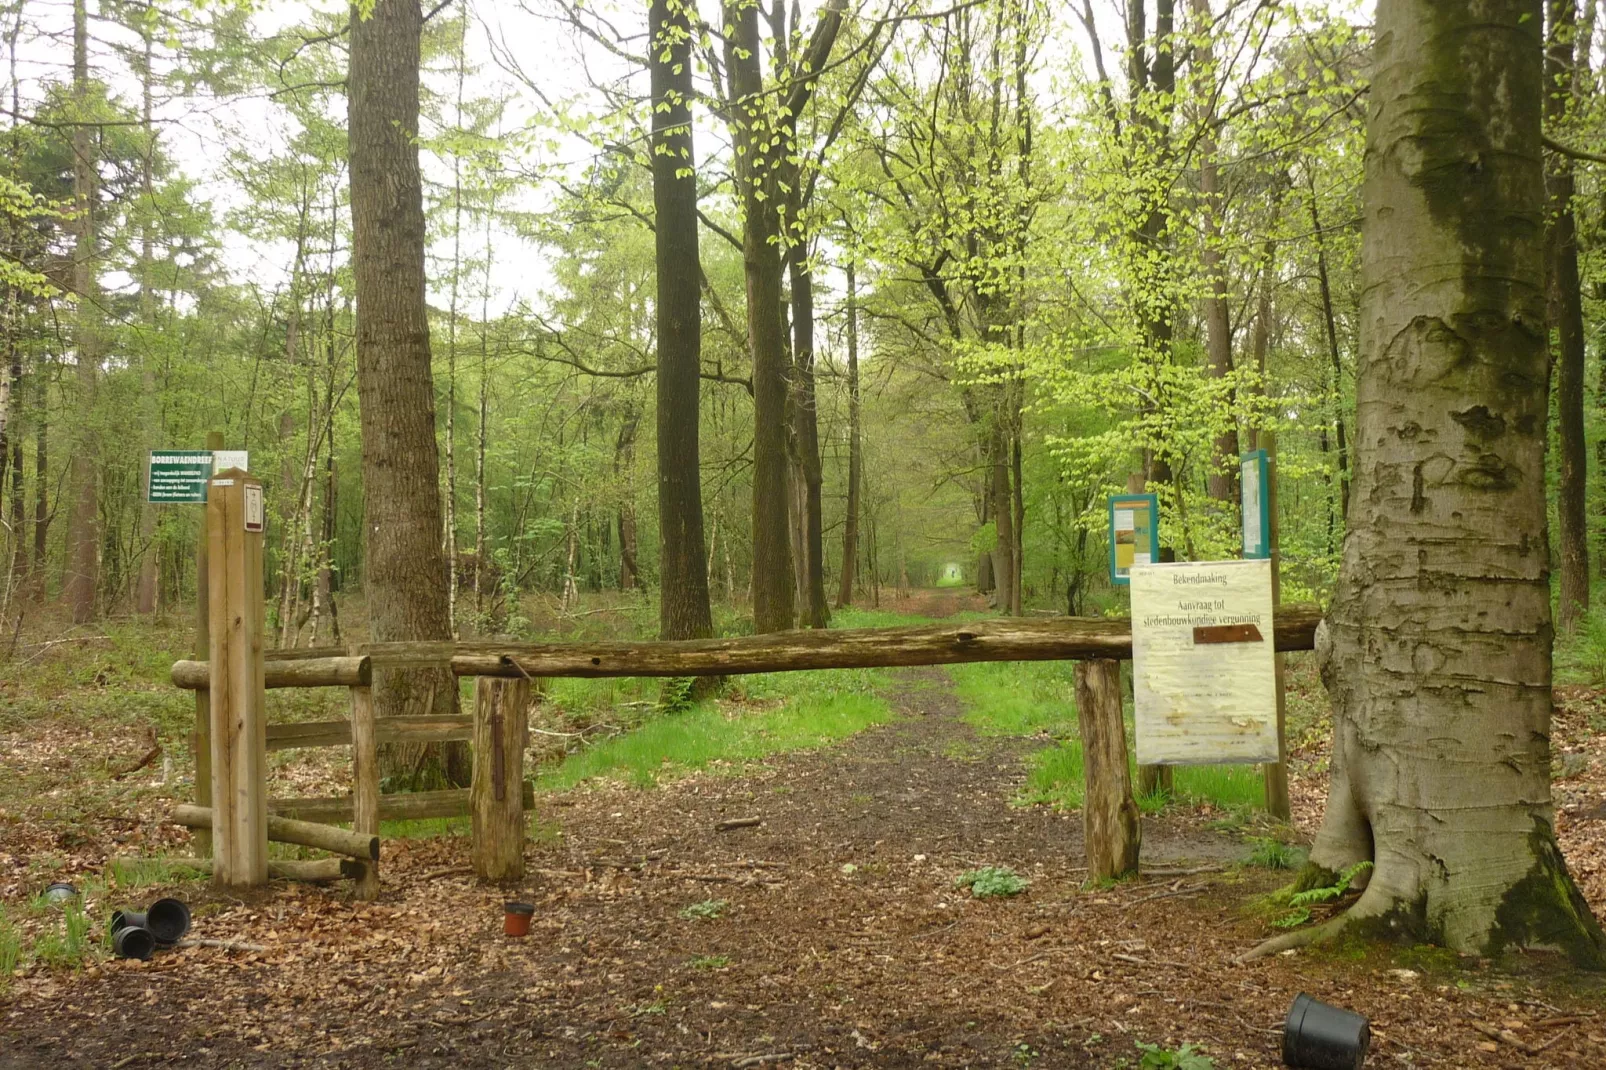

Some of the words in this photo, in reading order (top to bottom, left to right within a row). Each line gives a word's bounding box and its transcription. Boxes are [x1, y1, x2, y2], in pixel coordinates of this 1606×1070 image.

[1173, 572, 1228, 586] Bekendmaking
[1177, 601, 1213, 613] Aanvraag
[1214, 599, 1225, 610] tot
[1144, 614, 1218, 627] stedenbouwkundige
[1219, 612, 1261, 627] vergunning
